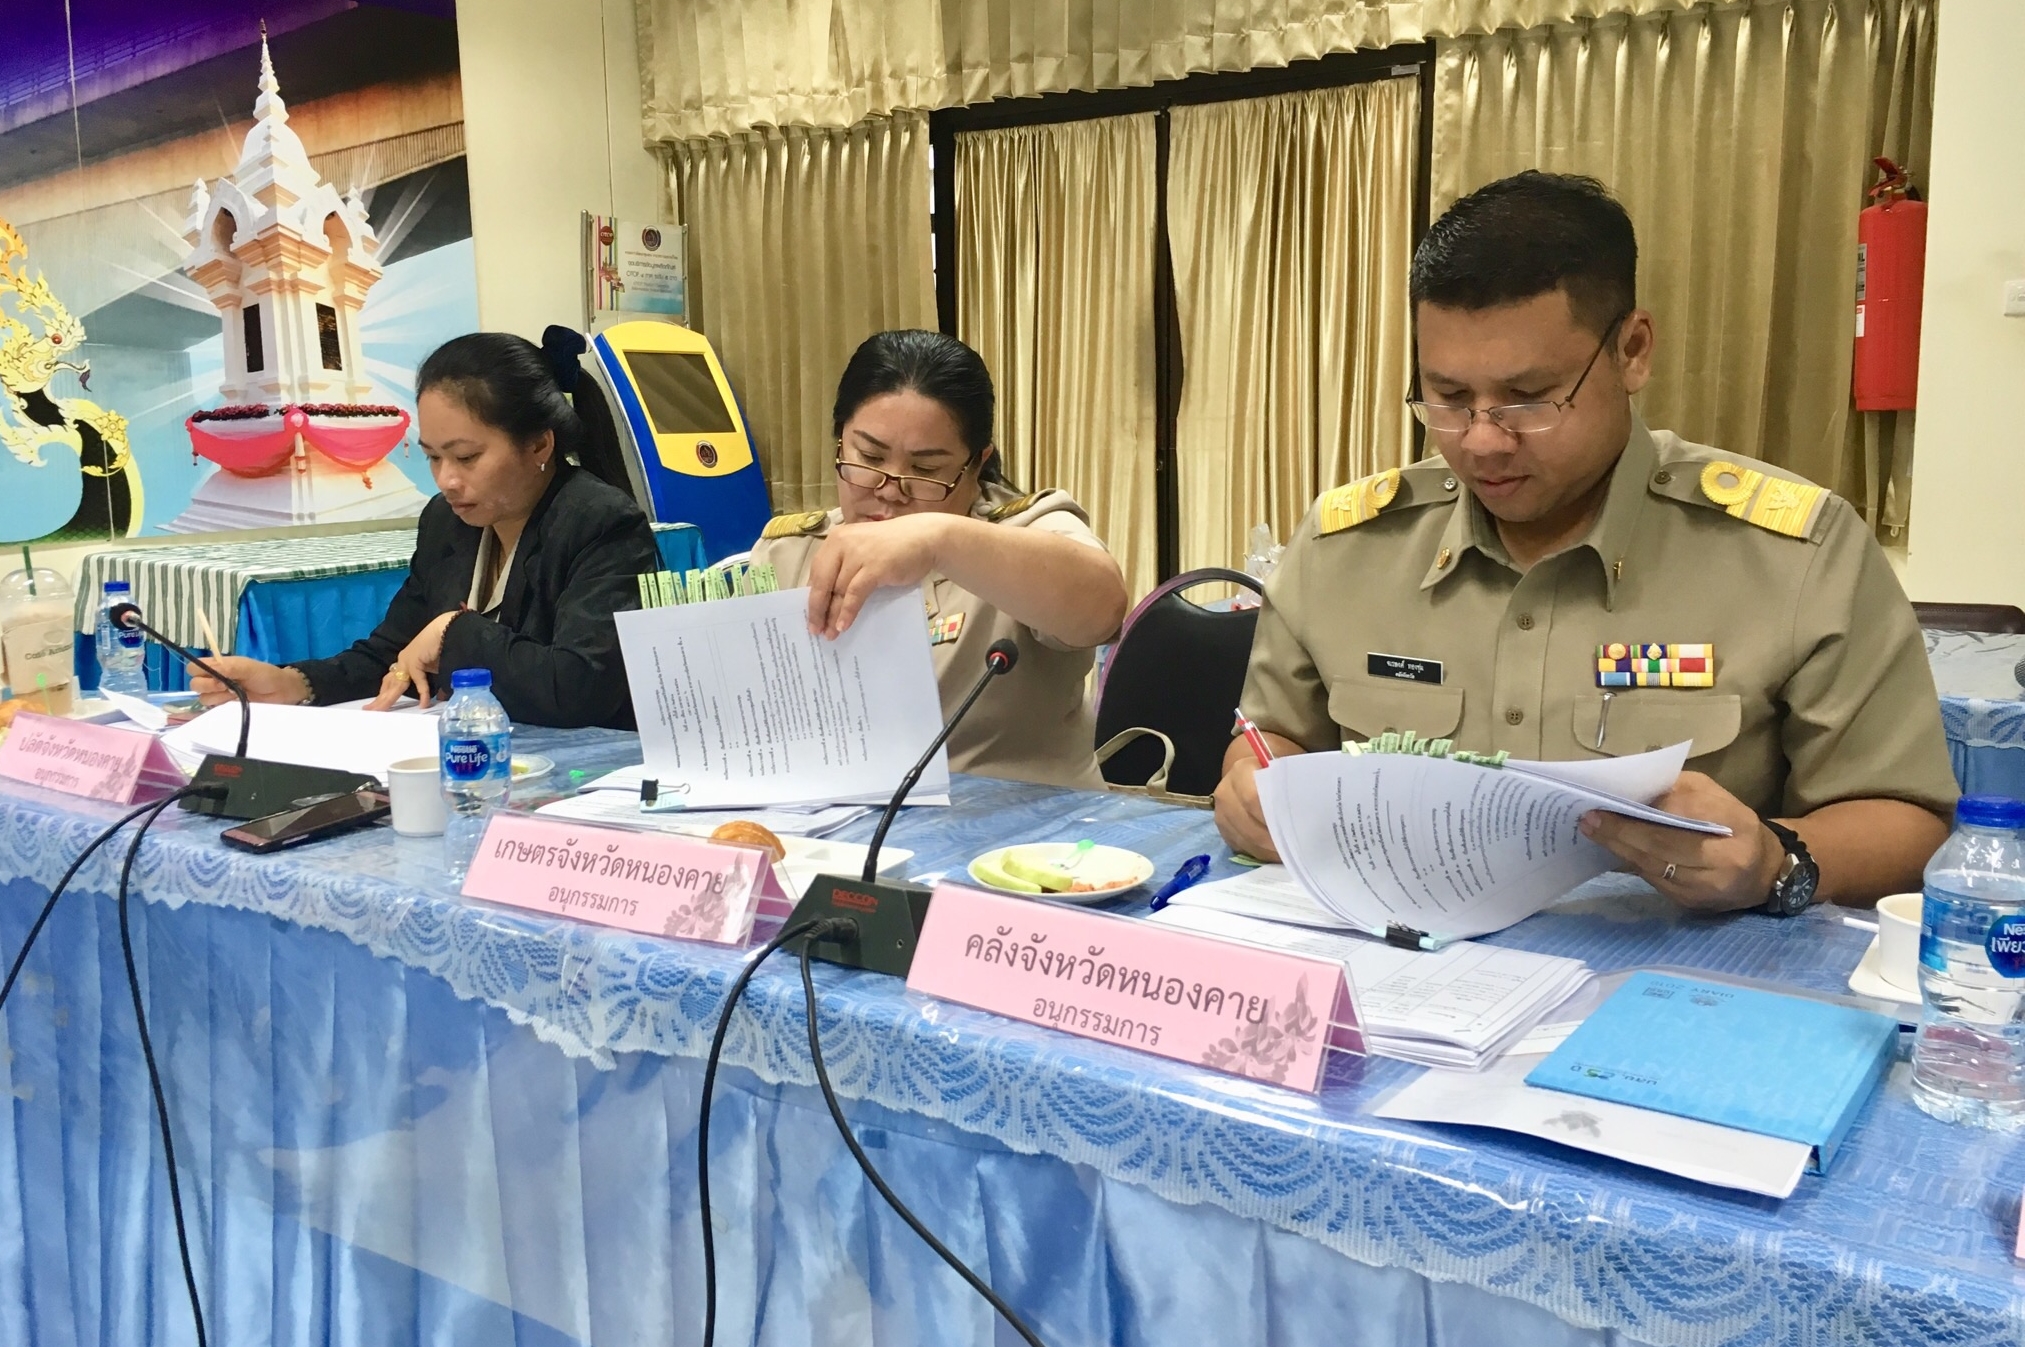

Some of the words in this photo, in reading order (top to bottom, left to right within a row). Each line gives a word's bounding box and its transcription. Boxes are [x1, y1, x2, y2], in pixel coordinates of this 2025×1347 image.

[445, 752, 468, 764] Pure
[468, 752, 488, 767] Life
[494, 838, 729, 895] เกษตรจังหวัดหนองคาย
[548, 885, 639, 917] อนุกรรมการ
[964, 925, 1268, 1025] คลังจังหวัดหนองคาย
[1032, 997, 1162, 1047] อนุกรรมการ
